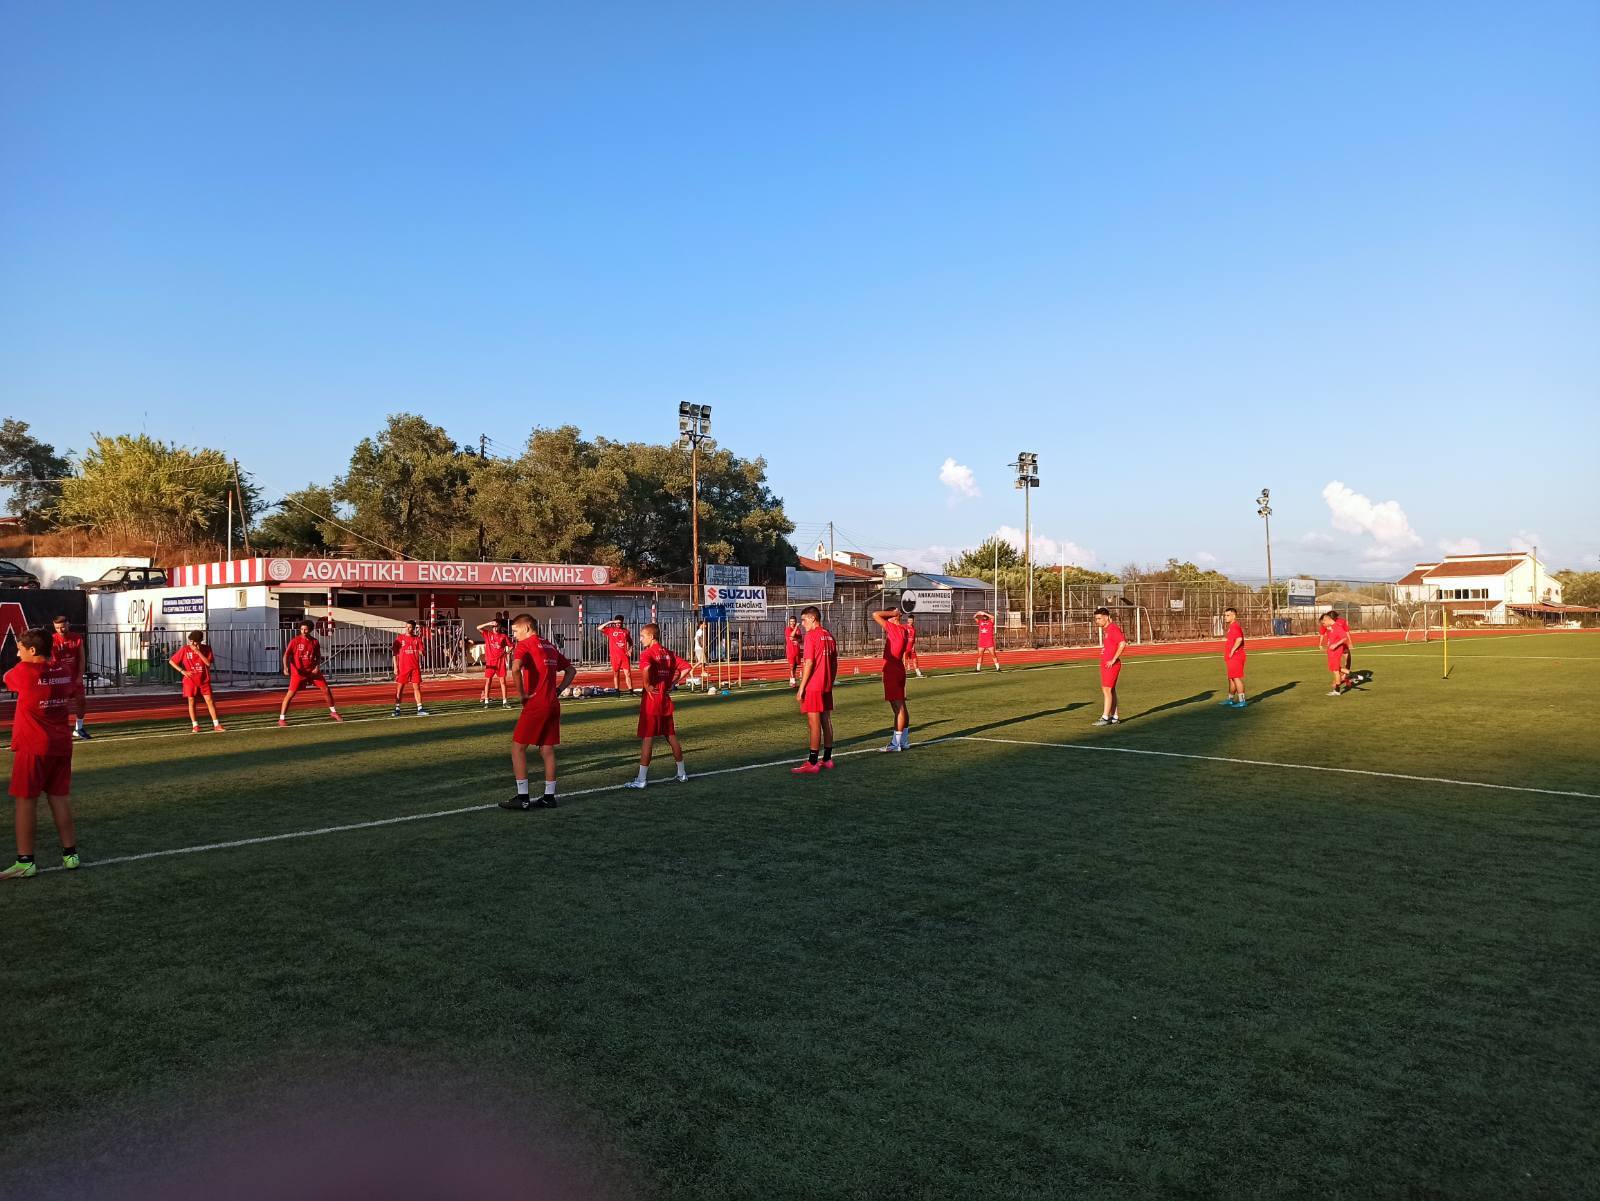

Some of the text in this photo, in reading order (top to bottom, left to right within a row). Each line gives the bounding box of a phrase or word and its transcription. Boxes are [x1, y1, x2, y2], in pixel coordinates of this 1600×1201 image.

[302, 561, 404, 581] ΑΘΛΗΤΙΚΗ
[418, 564, 479, 582] ΕΝΩΣΗ
[490, 566, 585, 583] ΛΕΥΚΙΜΜΗΣ
[718, 588, 765, 600] SUZUKI
